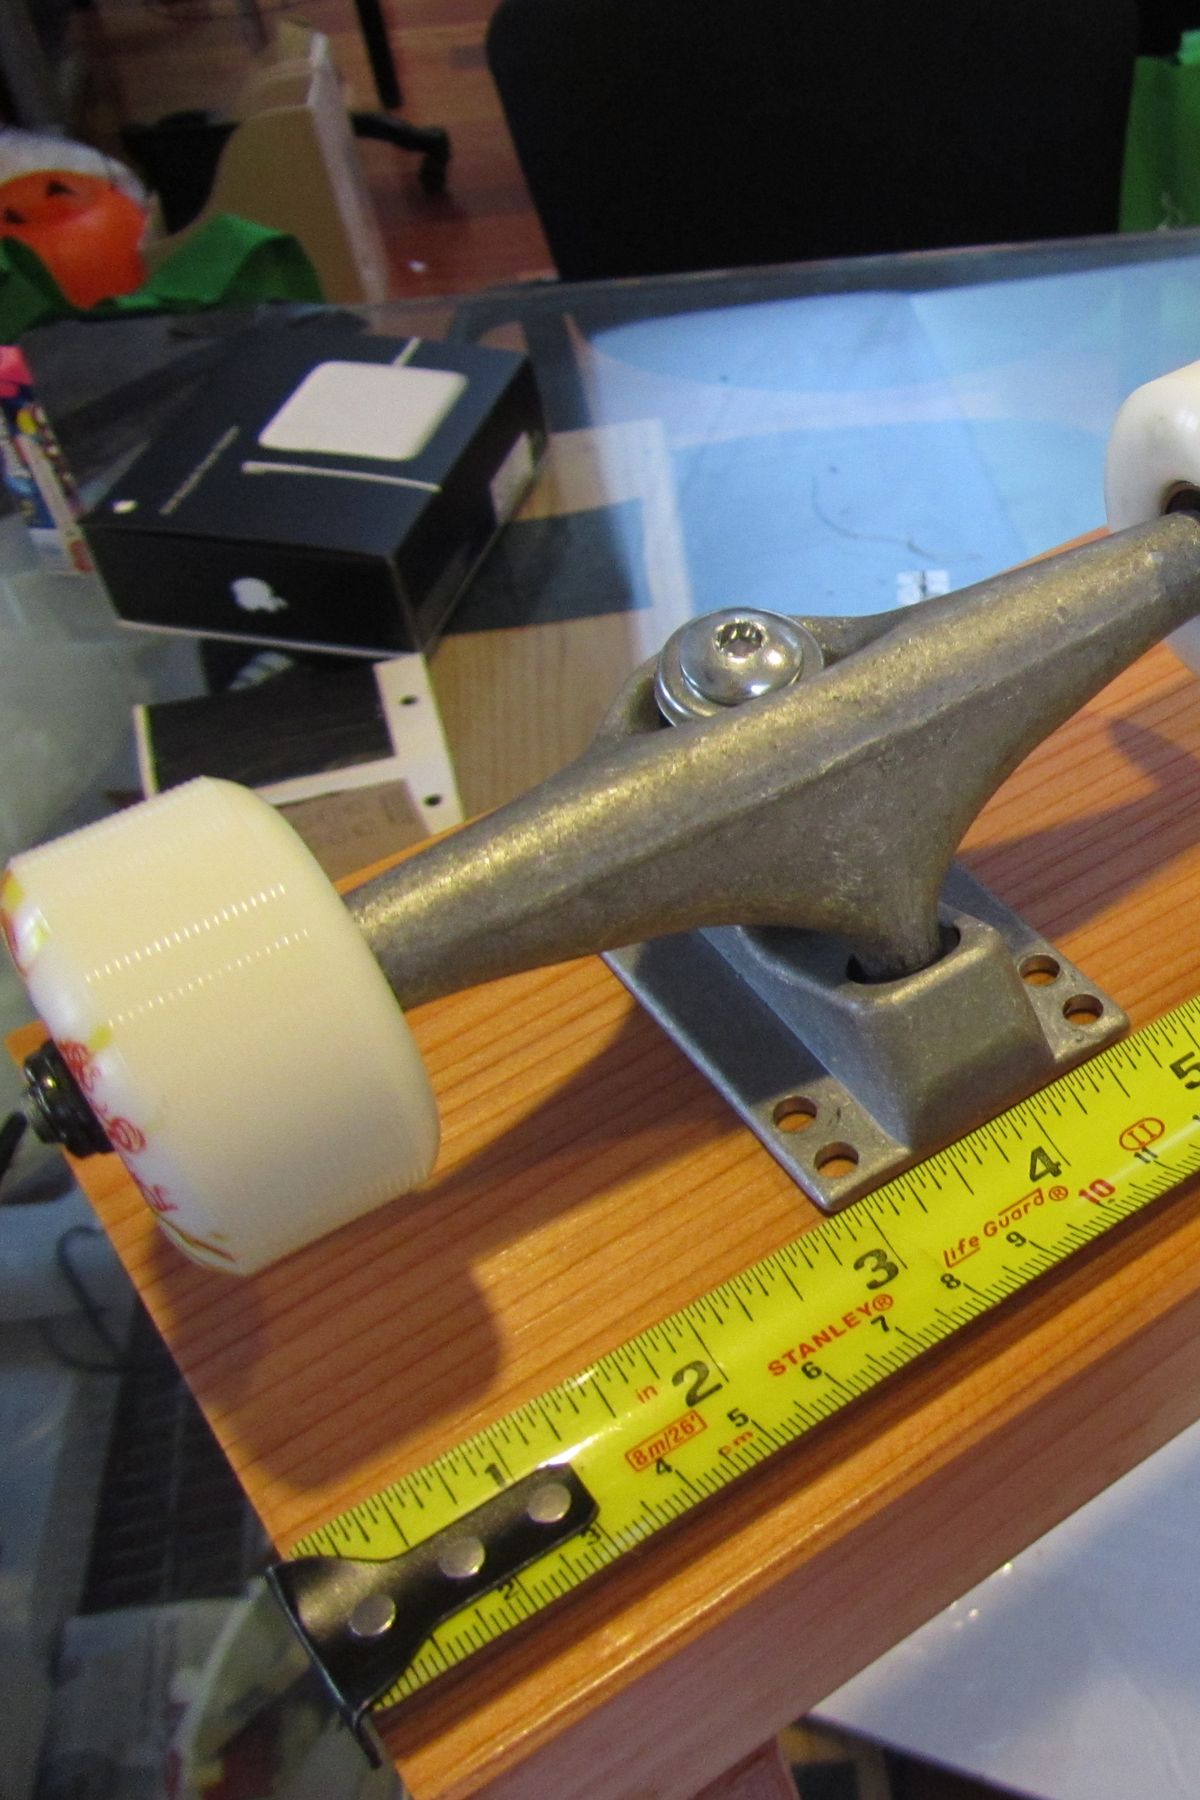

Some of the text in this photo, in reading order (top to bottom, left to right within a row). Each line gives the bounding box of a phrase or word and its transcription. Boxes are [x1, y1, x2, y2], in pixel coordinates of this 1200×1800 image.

[1029, 1146, 1062, 1182] 4
[1133, 1145, 1158, 1165] 11
[1078, 1178, 1116, 1206] 10
[1006, 1231, 1027, 1248] 9
[853, 1248, 899, 1290] 3
[940, 1273, 961, 1291] 8
[870, 1315, 890, 1333] 7
[801, 1361, 822, 1380] 6
[672, 1360, 723, 1407] 2
[635, 1385, 658, 1404] in
[727, 1407, 749, 1427] 5
[484, 1462, 506, 1489] 1
[656, 1457, 673, 1475] 4
